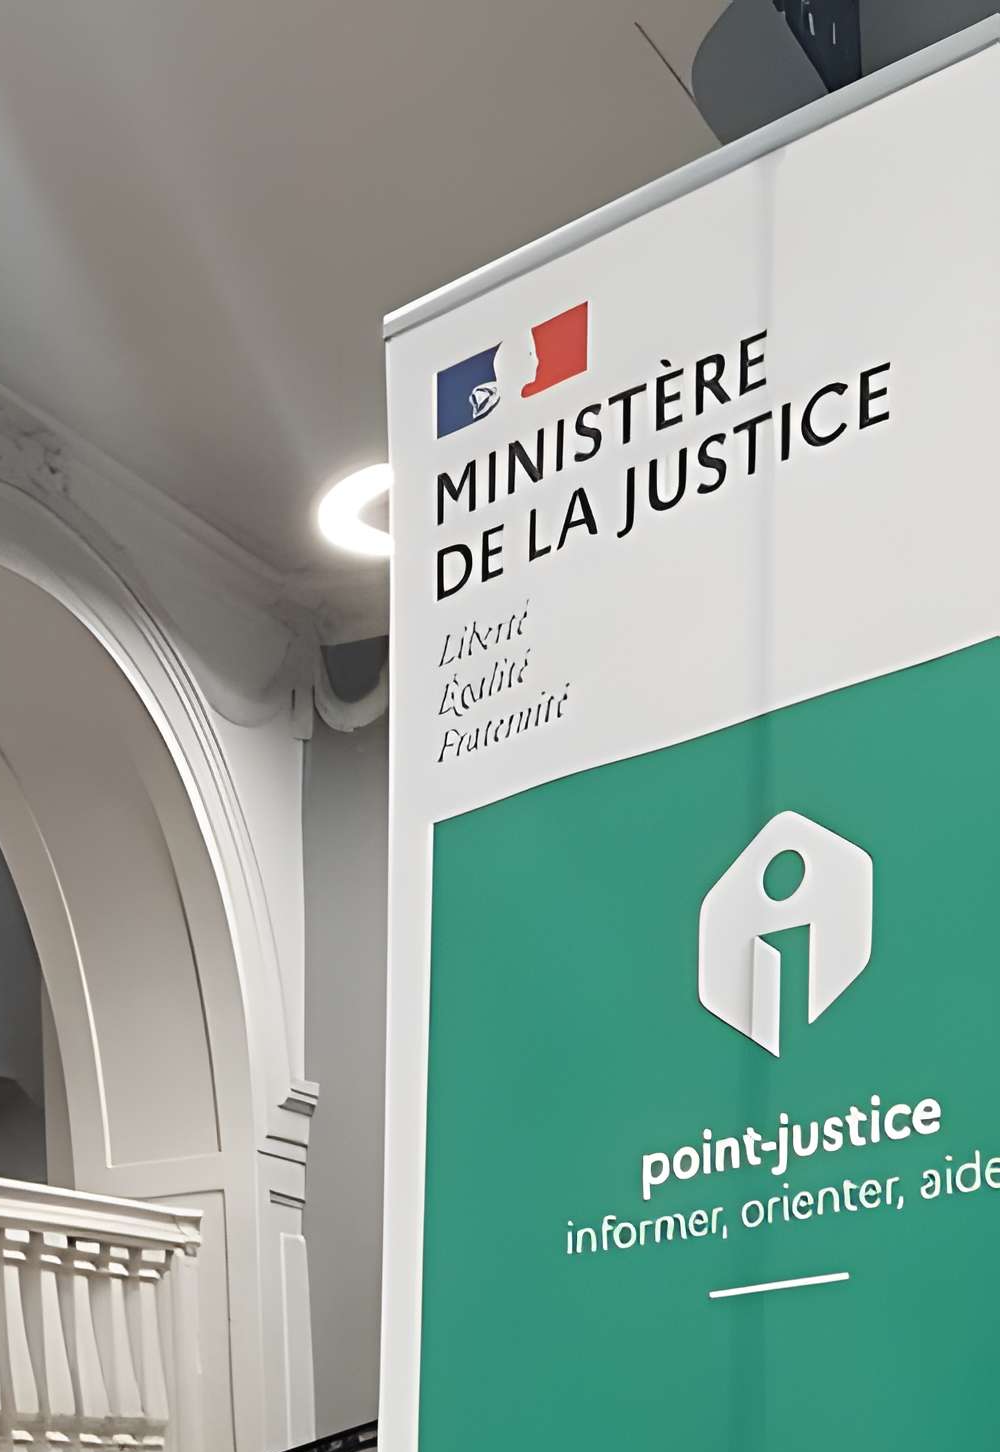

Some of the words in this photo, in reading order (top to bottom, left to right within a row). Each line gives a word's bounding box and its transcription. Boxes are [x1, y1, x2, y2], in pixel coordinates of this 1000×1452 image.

[436, 329, 768, 526] MINISTÈRE
[436, 523, 505, 602] DE
[528, 487, 598, 562] LA
[616, 361, 891, 539] JUSTICE
[566, 1206, 728, 1255] informer,
[741, 1176, 904, 1228] orienter,
[642, 1094, 942, 1201] point-justice
